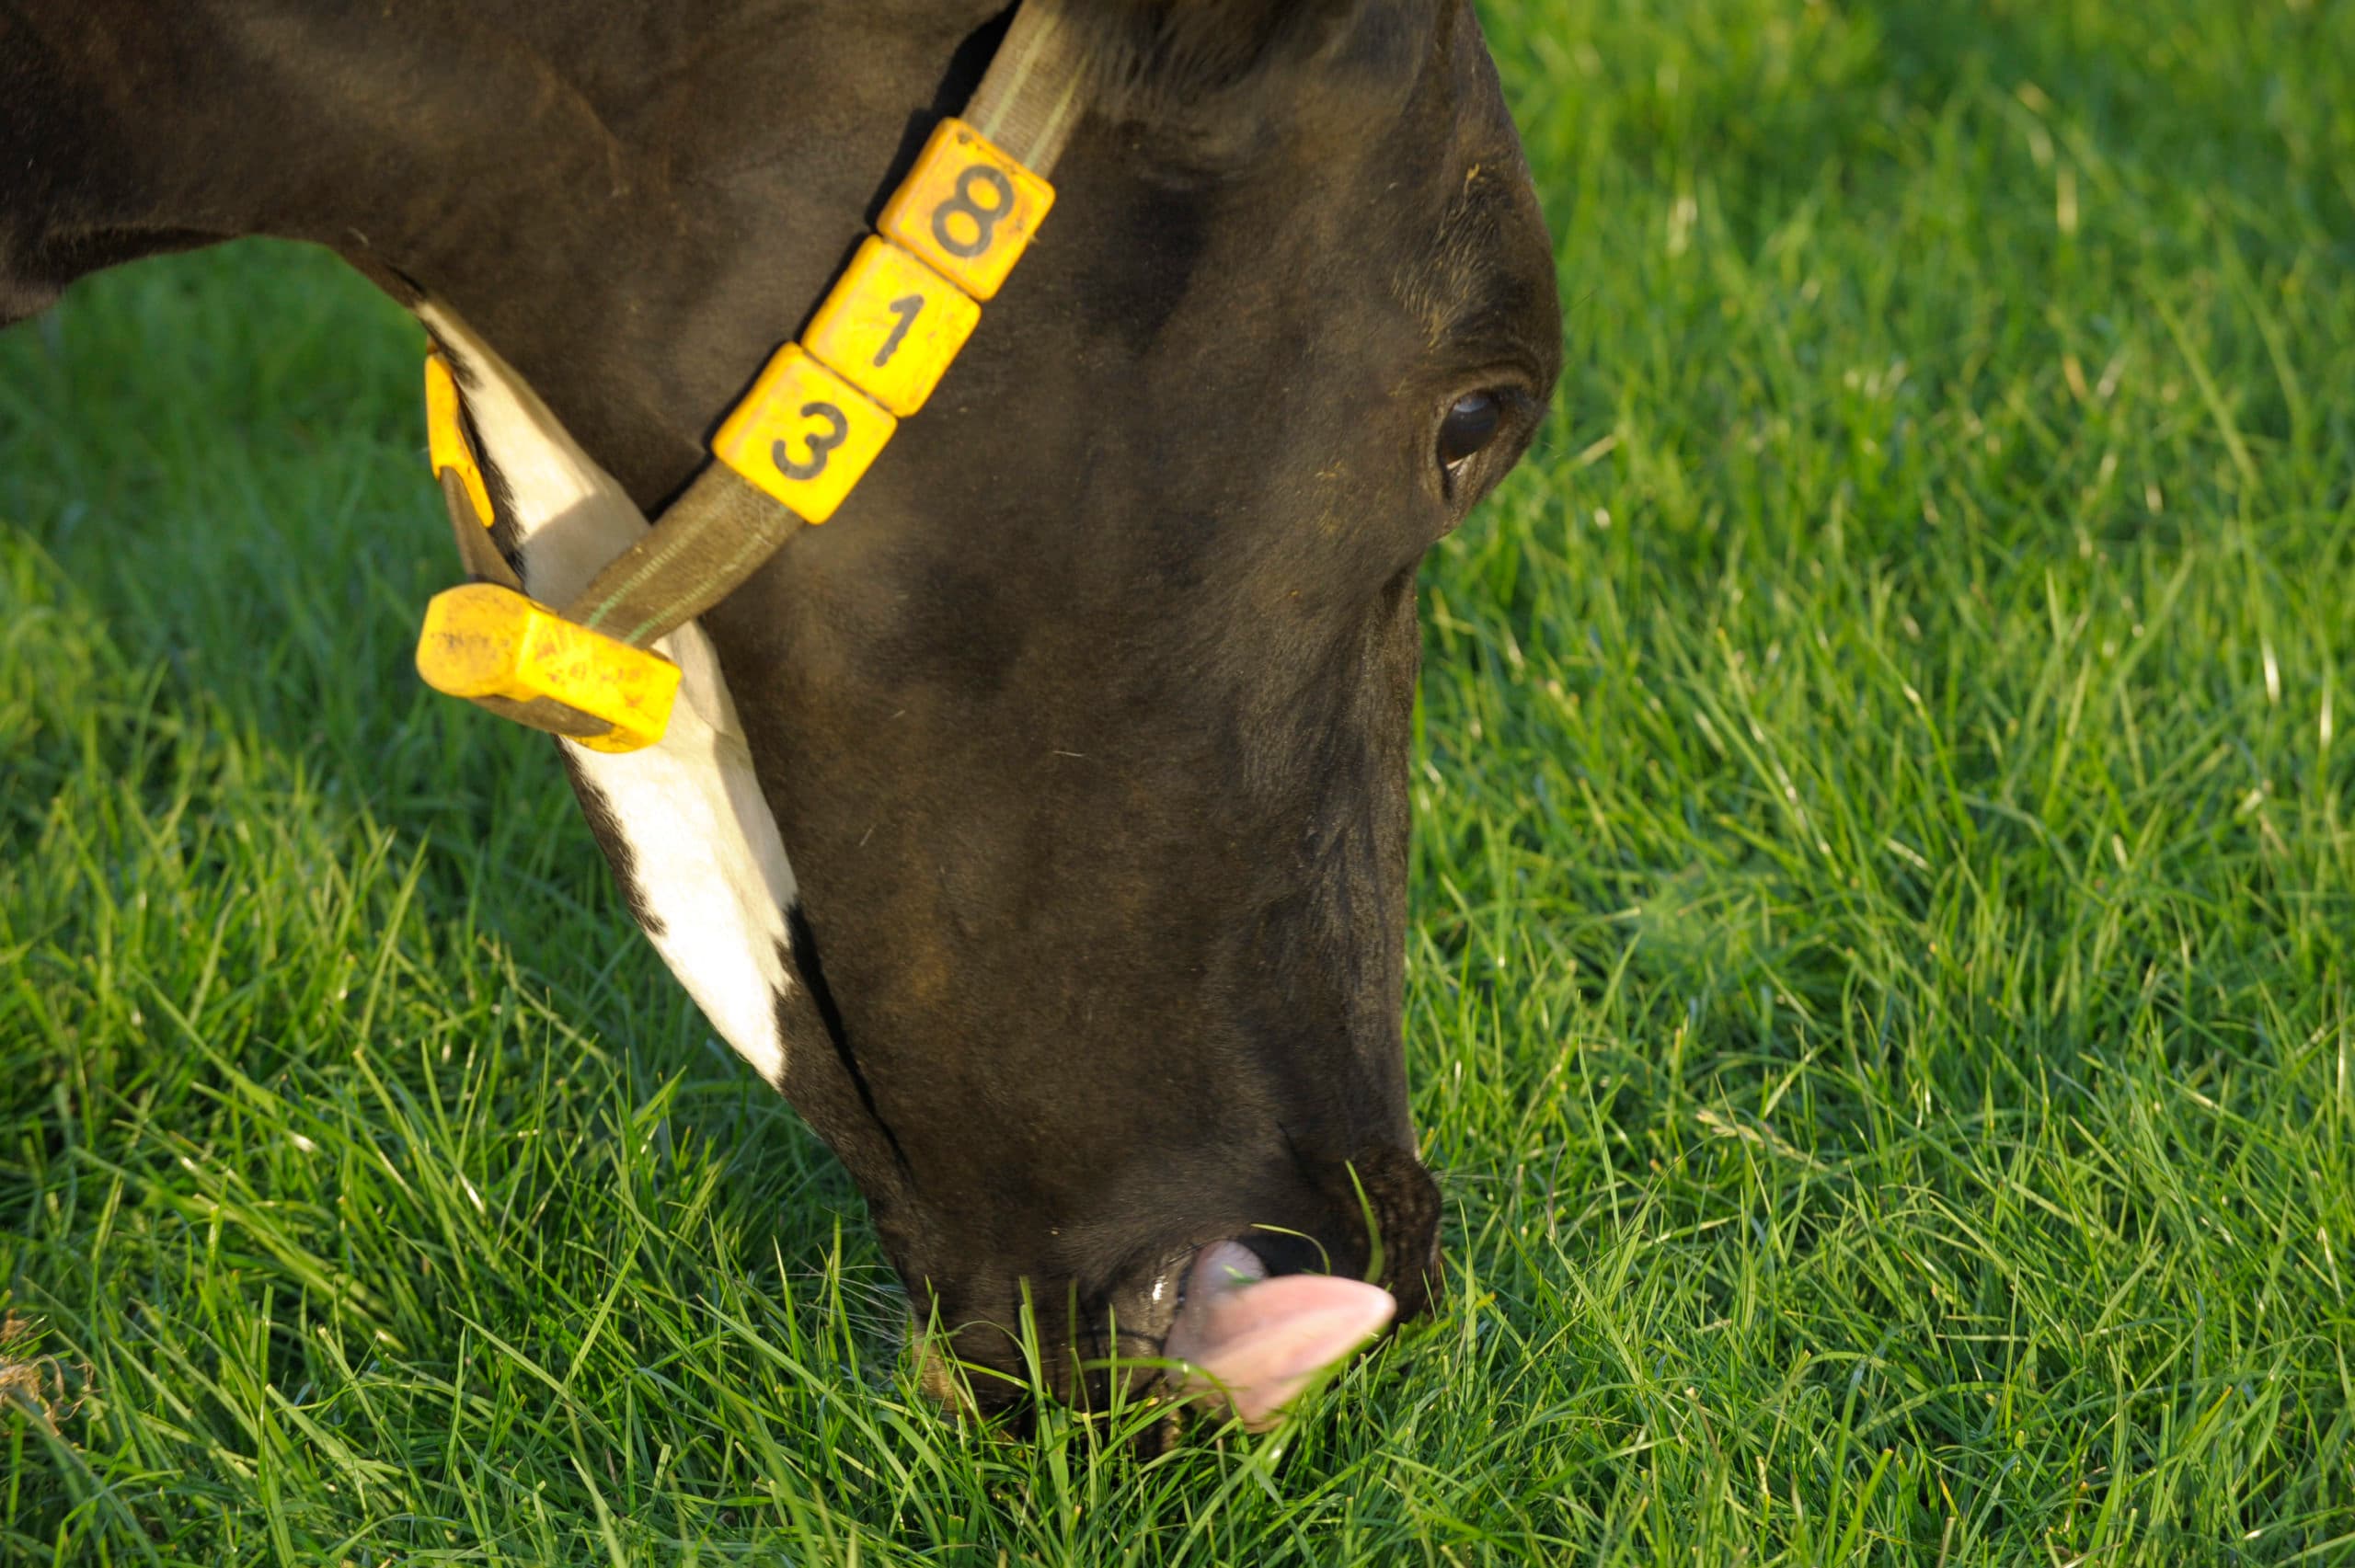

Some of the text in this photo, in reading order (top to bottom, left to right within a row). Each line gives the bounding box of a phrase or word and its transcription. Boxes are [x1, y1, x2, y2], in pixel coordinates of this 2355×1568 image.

[931, 164, 1016, 258] 8
[873, 293, 925, 368] 1
[771, 401, 848, 481] 3
